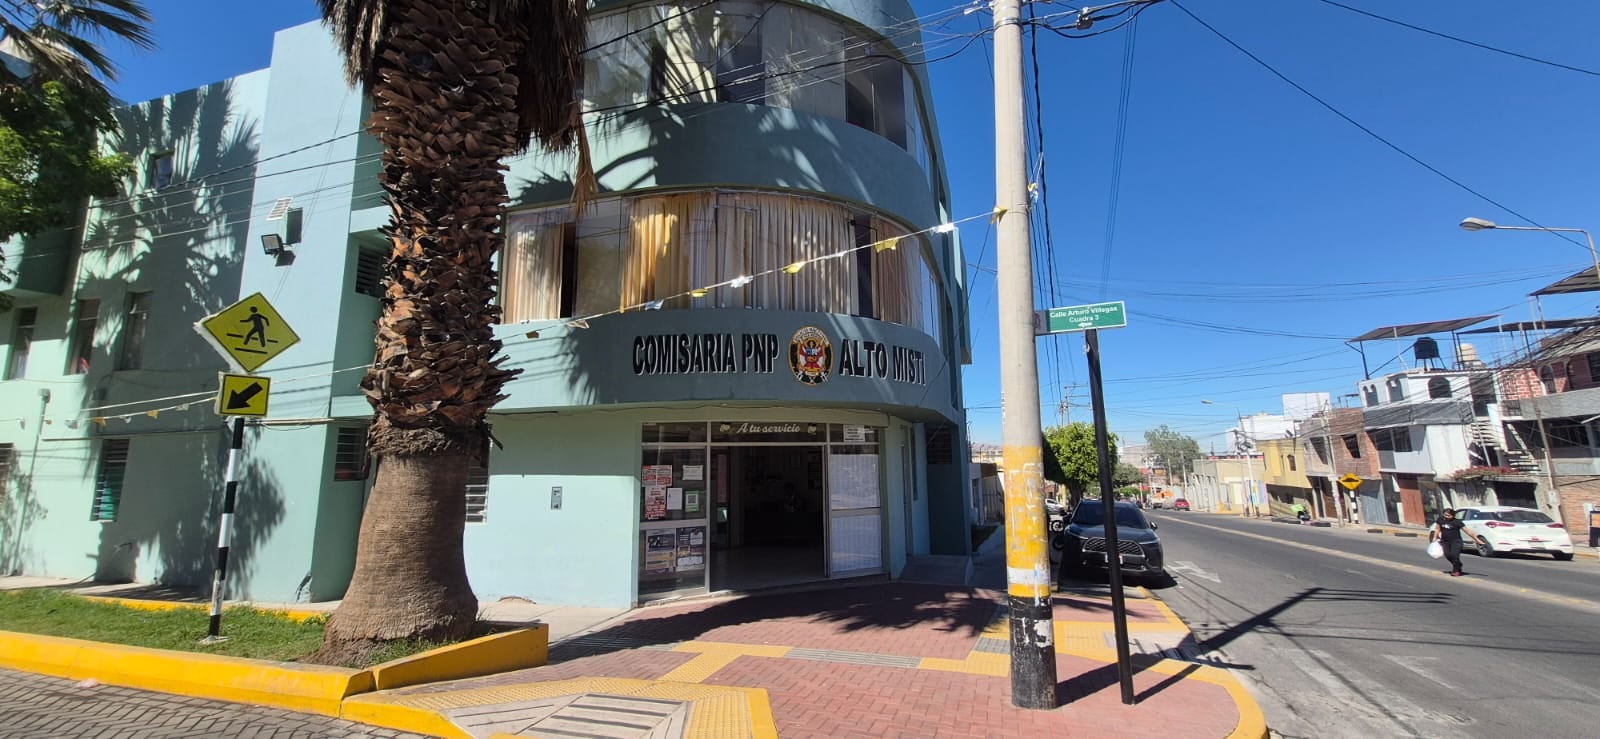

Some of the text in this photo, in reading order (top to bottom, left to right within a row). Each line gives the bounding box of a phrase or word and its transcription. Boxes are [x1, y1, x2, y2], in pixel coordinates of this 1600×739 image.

[1090, 306, 1118, 314] Villegas
[632, 333, 737, 376] COMISARIA
[742, 333, 779, 375] PNP
[838, 338, 889, 380] ALTO
[892, 345, 926, 386] MISTI
[736, 422, 801, 434] A tu servicio
